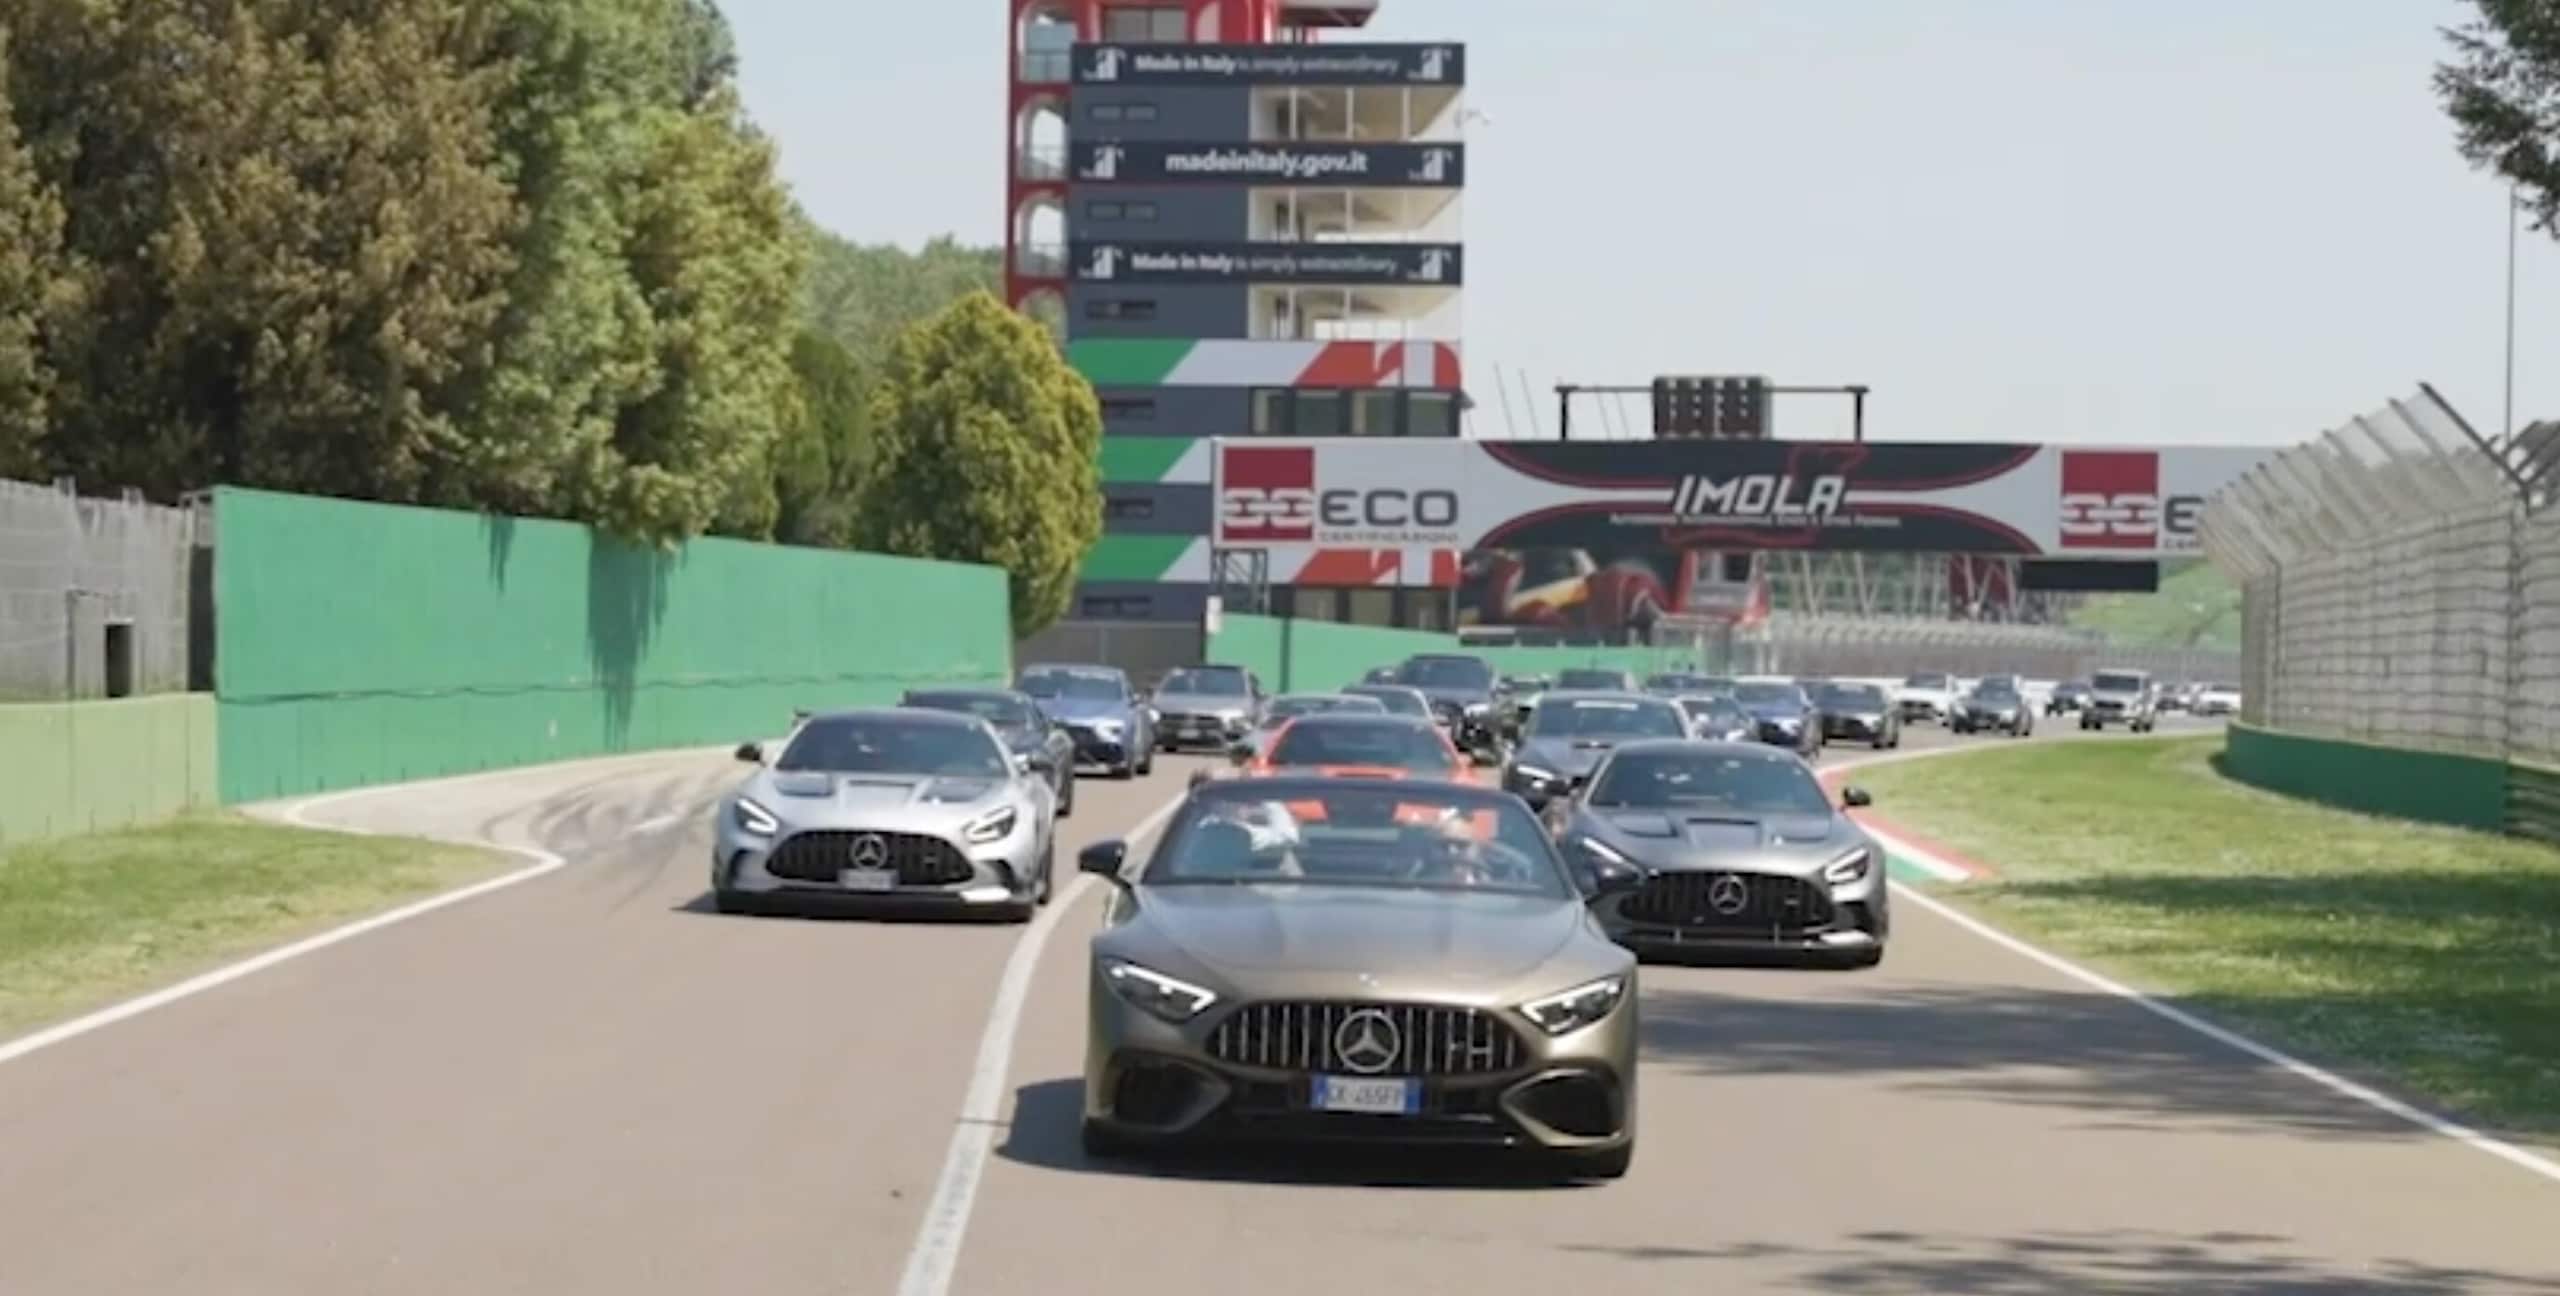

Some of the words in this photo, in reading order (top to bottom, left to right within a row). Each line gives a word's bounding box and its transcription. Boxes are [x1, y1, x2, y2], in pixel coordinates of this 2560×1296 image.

[1134, 54, 1180, 71] Made
[1183, 54, 1199, 71] in
[1202, 54, 1237, 76] Italy
[1165, 148, 1368, 177] madeinitaly.gov.it
[1131, 253, 1178, 271] Made
[1181, 252, 1196, 271] in
[1199, 253, 1233, 275] Italy
[1320, 489, 1459, 527] ECO
[1673, 474, 1844, 517] IMOLA
